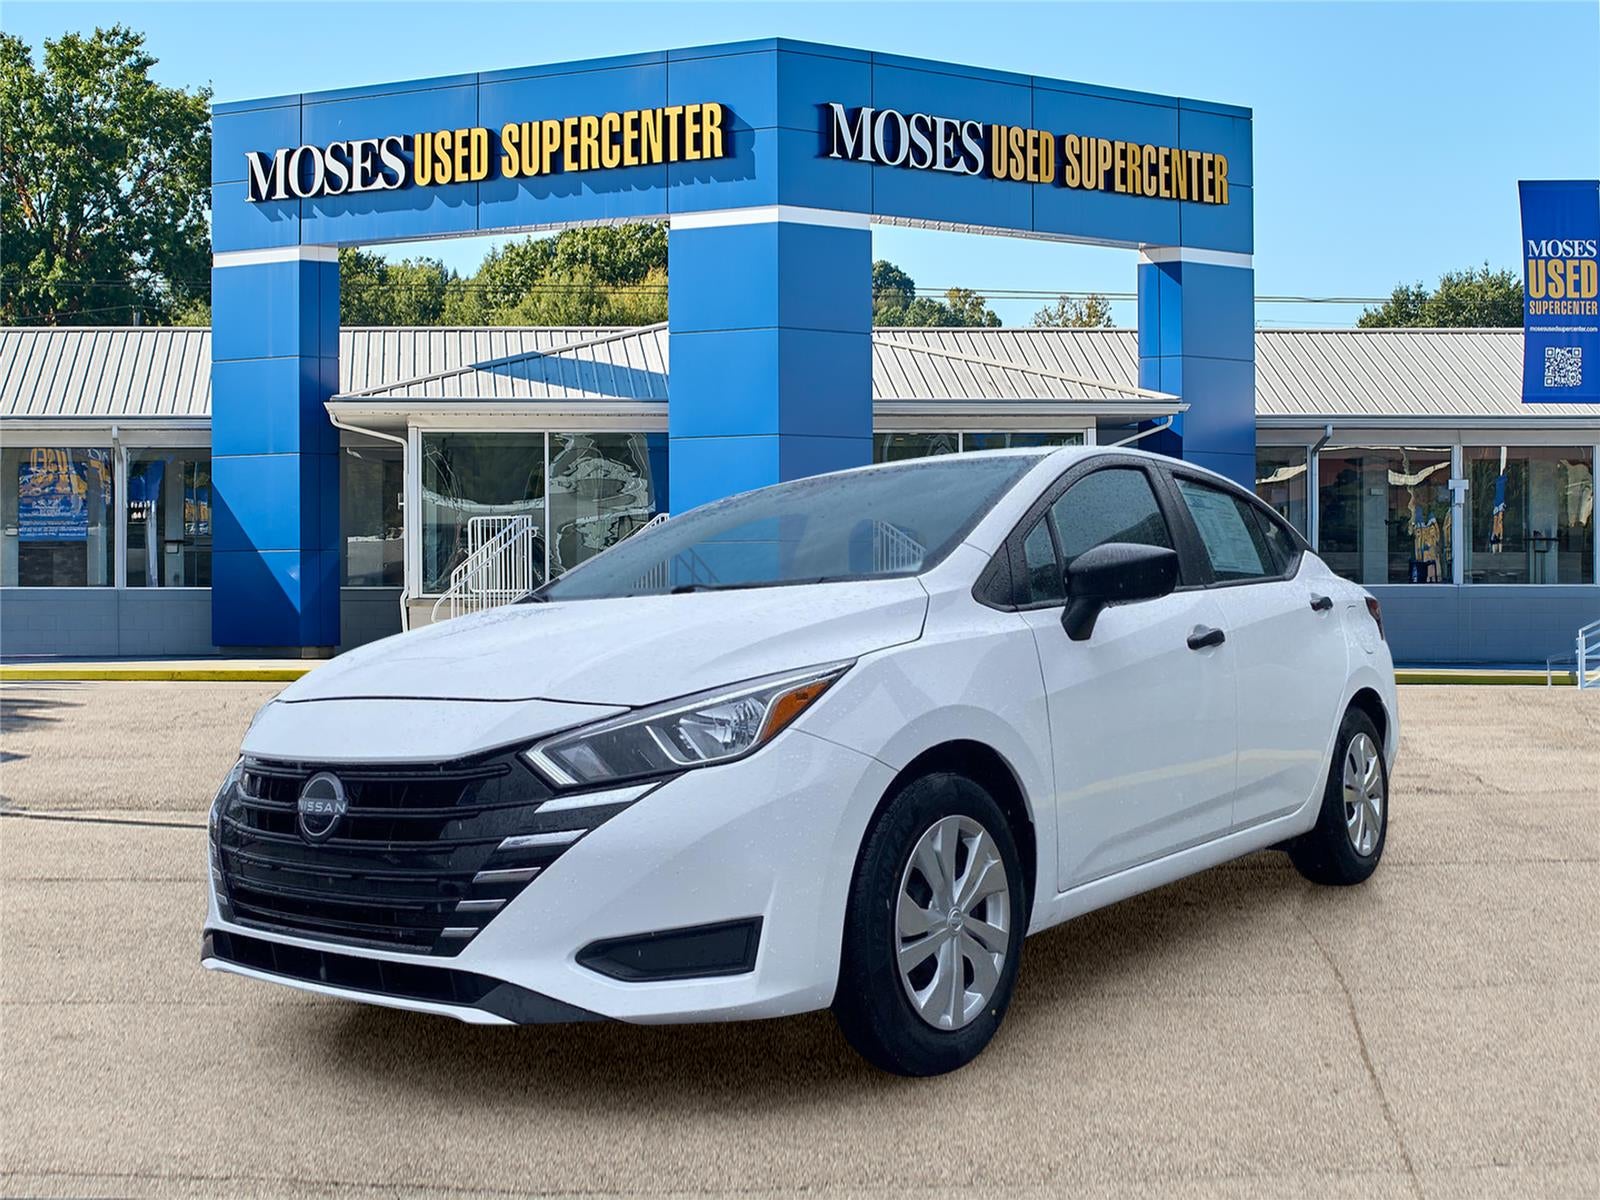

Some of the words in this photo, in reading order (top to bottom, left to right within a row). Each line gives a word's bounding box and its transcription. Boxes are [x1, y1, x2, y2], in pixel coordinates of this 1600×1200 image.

[245, 136, 406, 202] MOSES
[414, 127, 489, 187] USED
[501, 102, 723, 178] SUPERCENTER
[829, 102, 984, 175] MOSES
[991, 124, 1055, 183] USED
[1065, 134, 1229, 204] SUPERCENTER
[1527, 239, 1597, 258] MOSES
[1528, 259, 1598, 299] USED
[1529, 300, 1598, 316] SUPERCENTER
[299, 801, 346, 813] NISSAN
